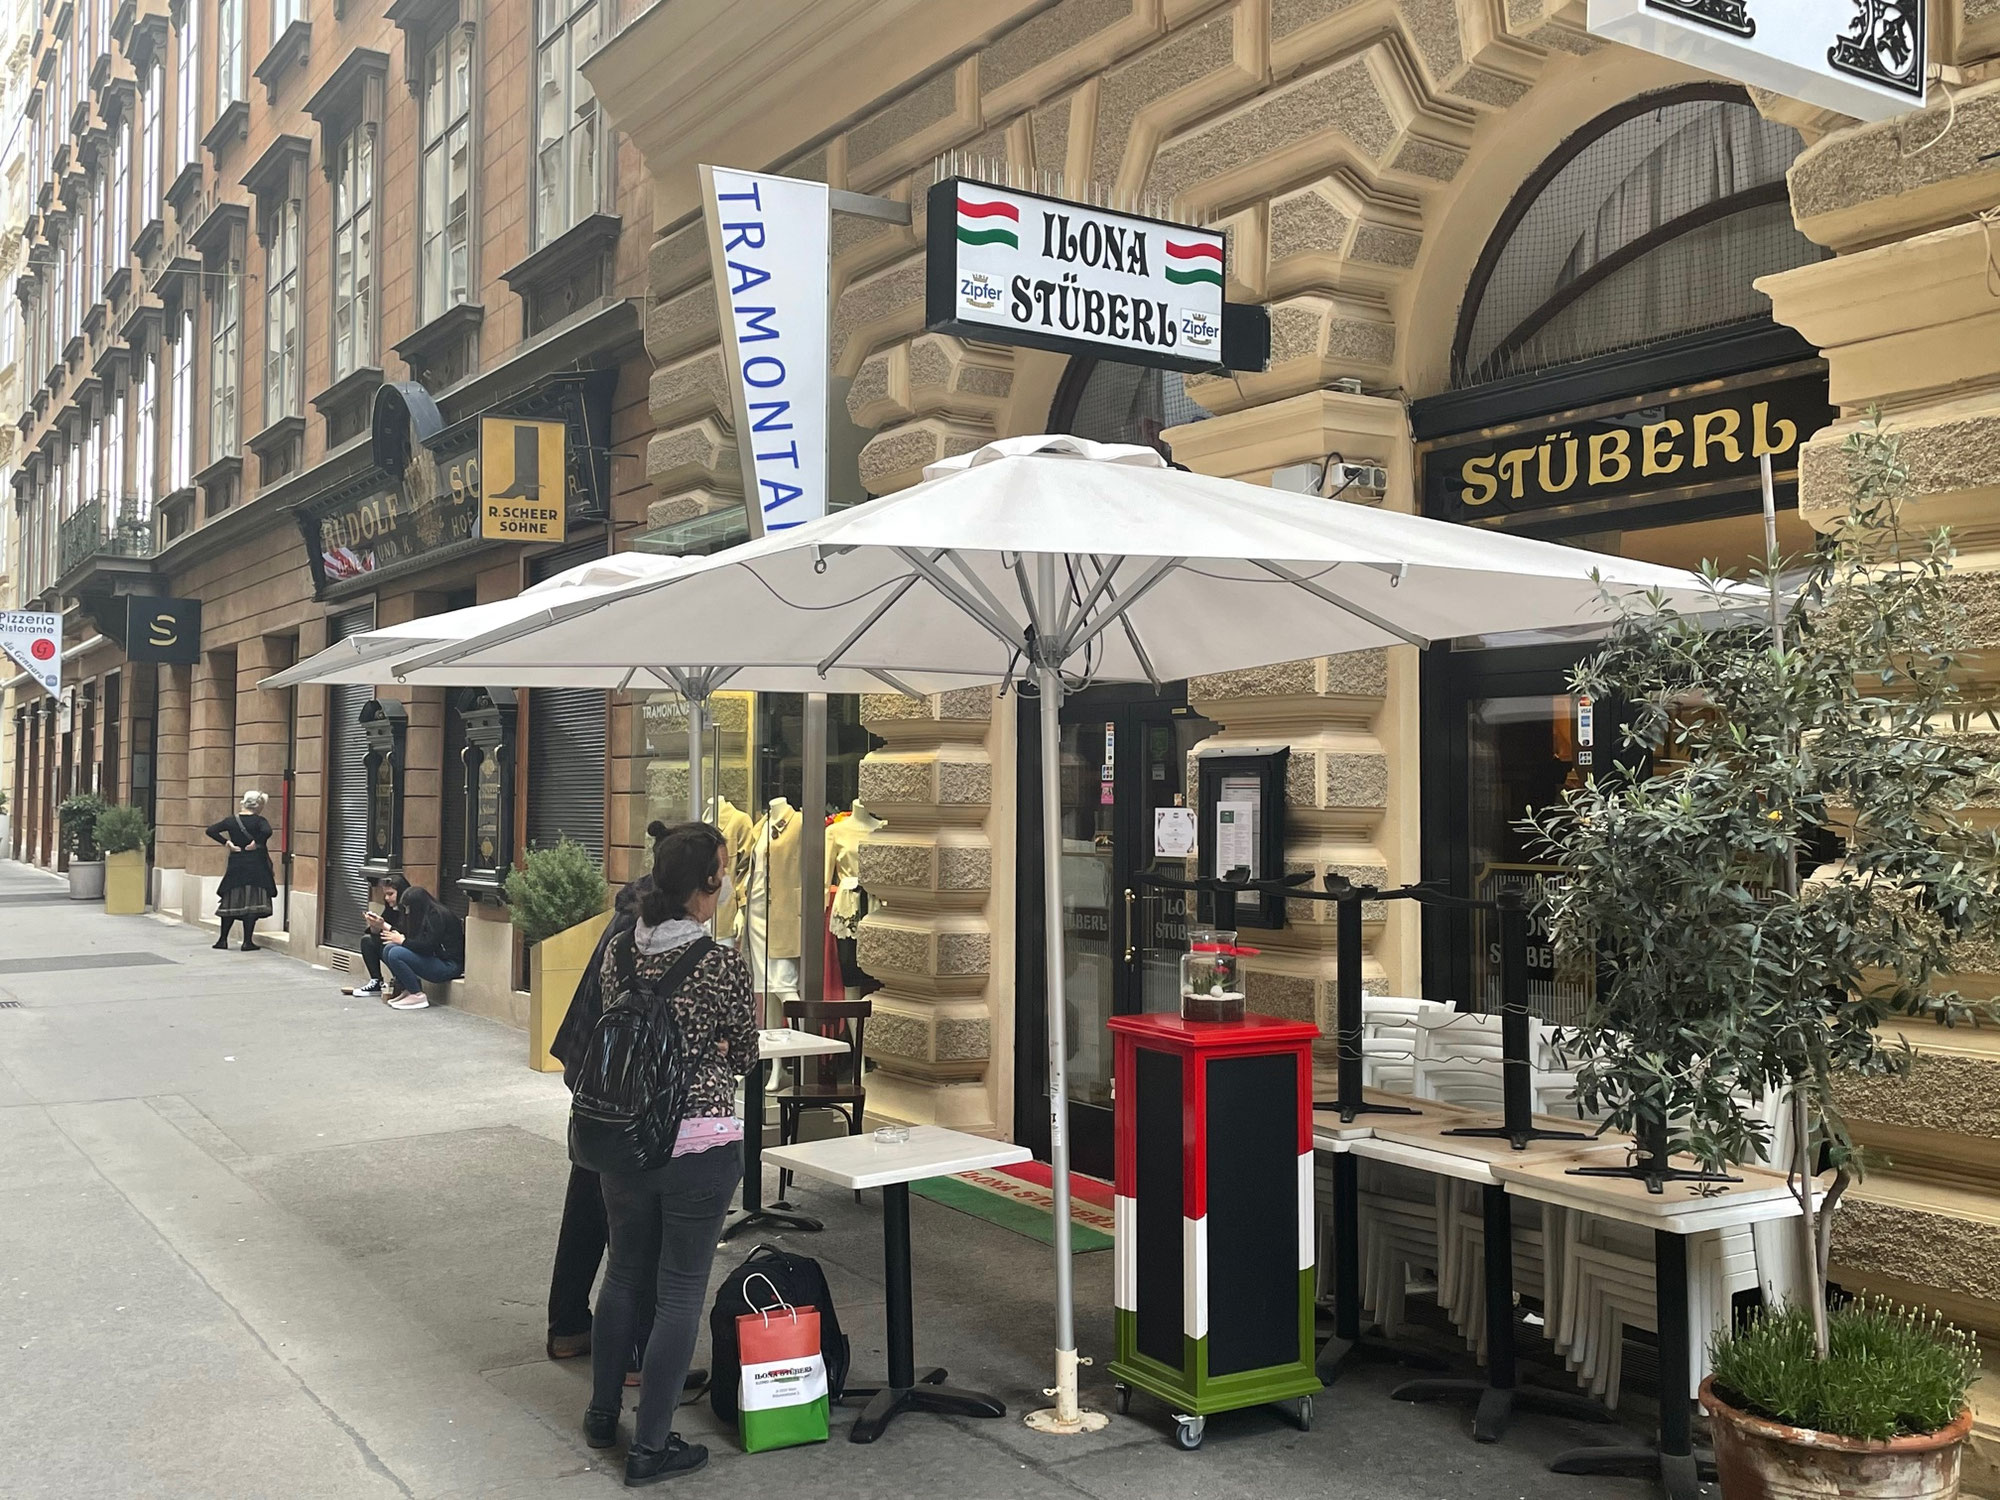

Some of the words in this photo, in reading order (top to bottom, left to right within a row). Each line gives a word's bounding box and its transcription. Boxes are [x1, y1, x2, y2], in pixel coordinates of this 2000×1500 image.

[1042, 211, 1150, 278] ILONA
[960, 279, 1003, 301] Zipfer
[1011, 272, 1178, 347] STÜBERL
[1182, 318, 1220, 338] Zipfer
[1460, 400, 1798, 506] STÜBERL
[320, 492, 400, 552] RUDOLF
[0, 612, 55, 625] Pizzeria
[0, 623, 54, 634] Ristorante
[14, 650, 45, 680] Gennaro
[1162, 898, 1185, 916] ILO
[1156, 920, 1187, 941] STÜB
